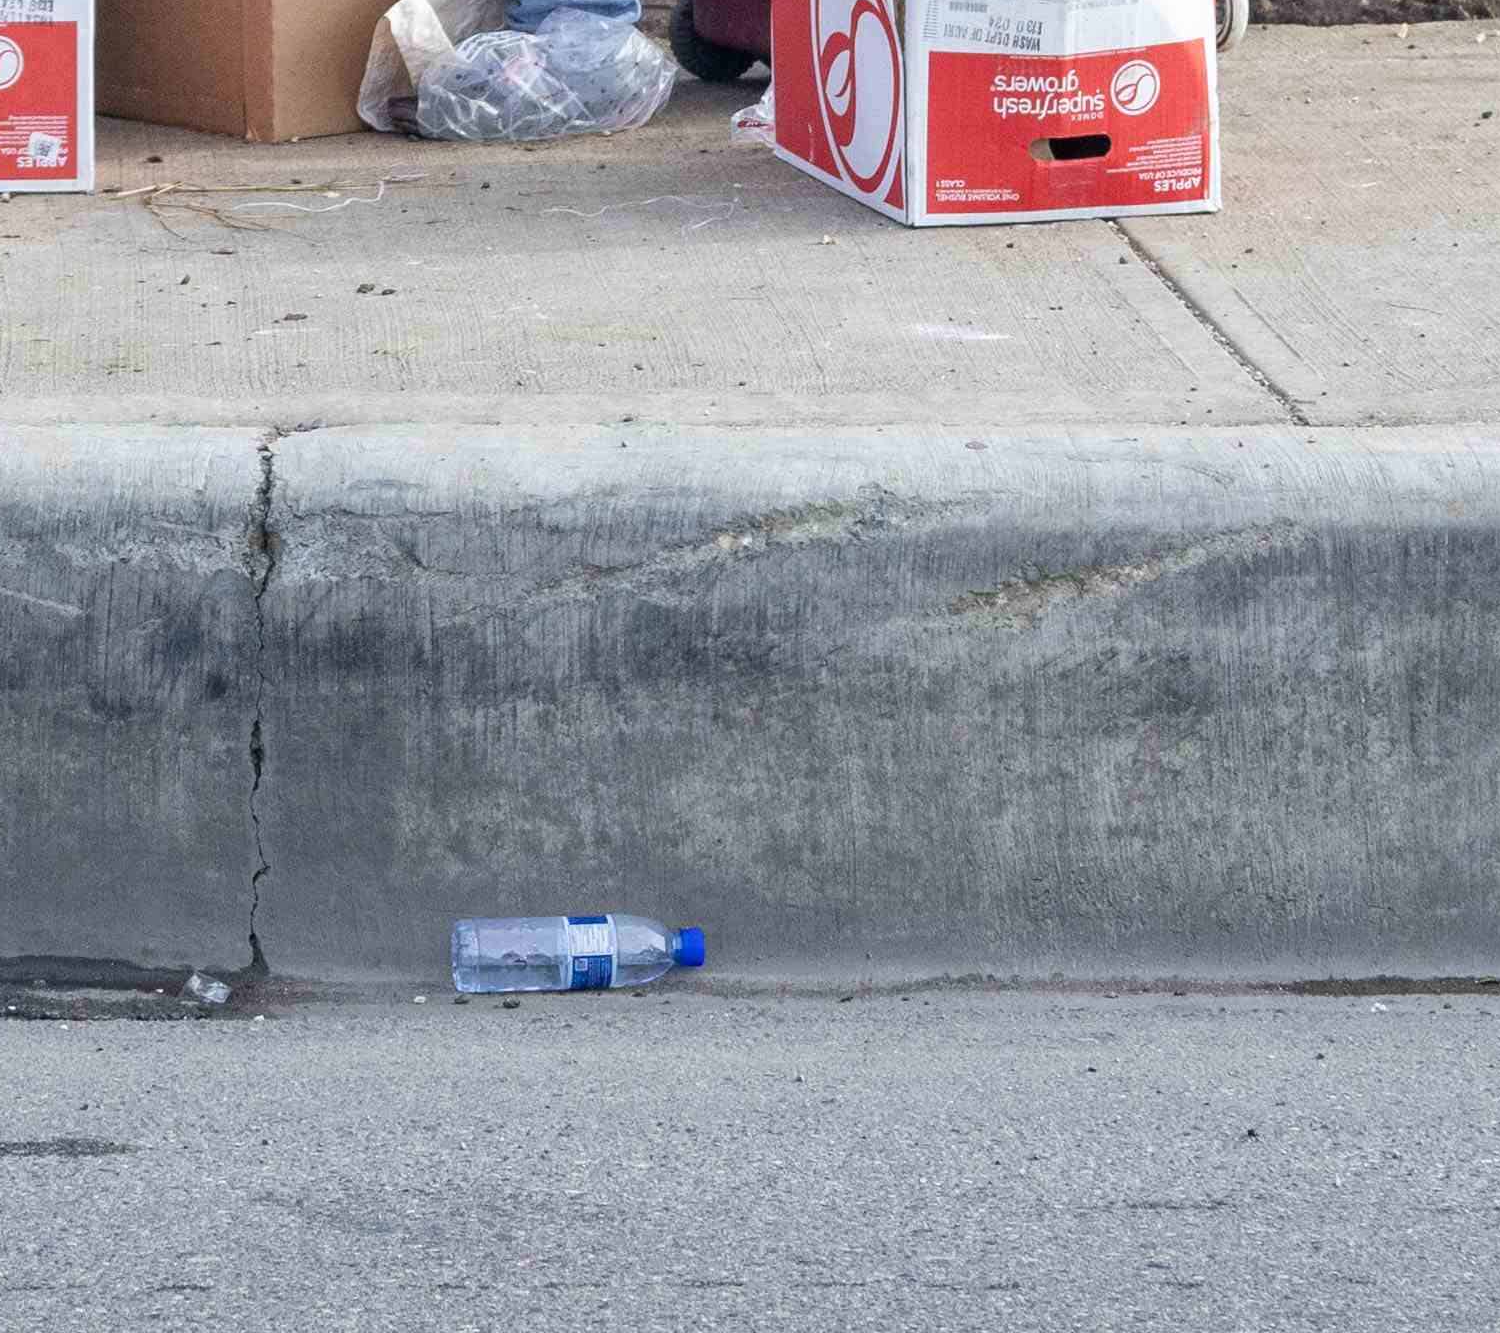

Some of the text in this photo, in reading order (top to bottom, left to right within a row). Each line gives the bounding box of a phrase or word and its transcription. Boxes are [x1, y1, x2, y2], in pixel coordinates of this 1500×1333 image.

[994, 69, 1079, 93] growers
[993, 90, 1105, 120] superfresh
[1153, 176, 1202, 192] APPLES
